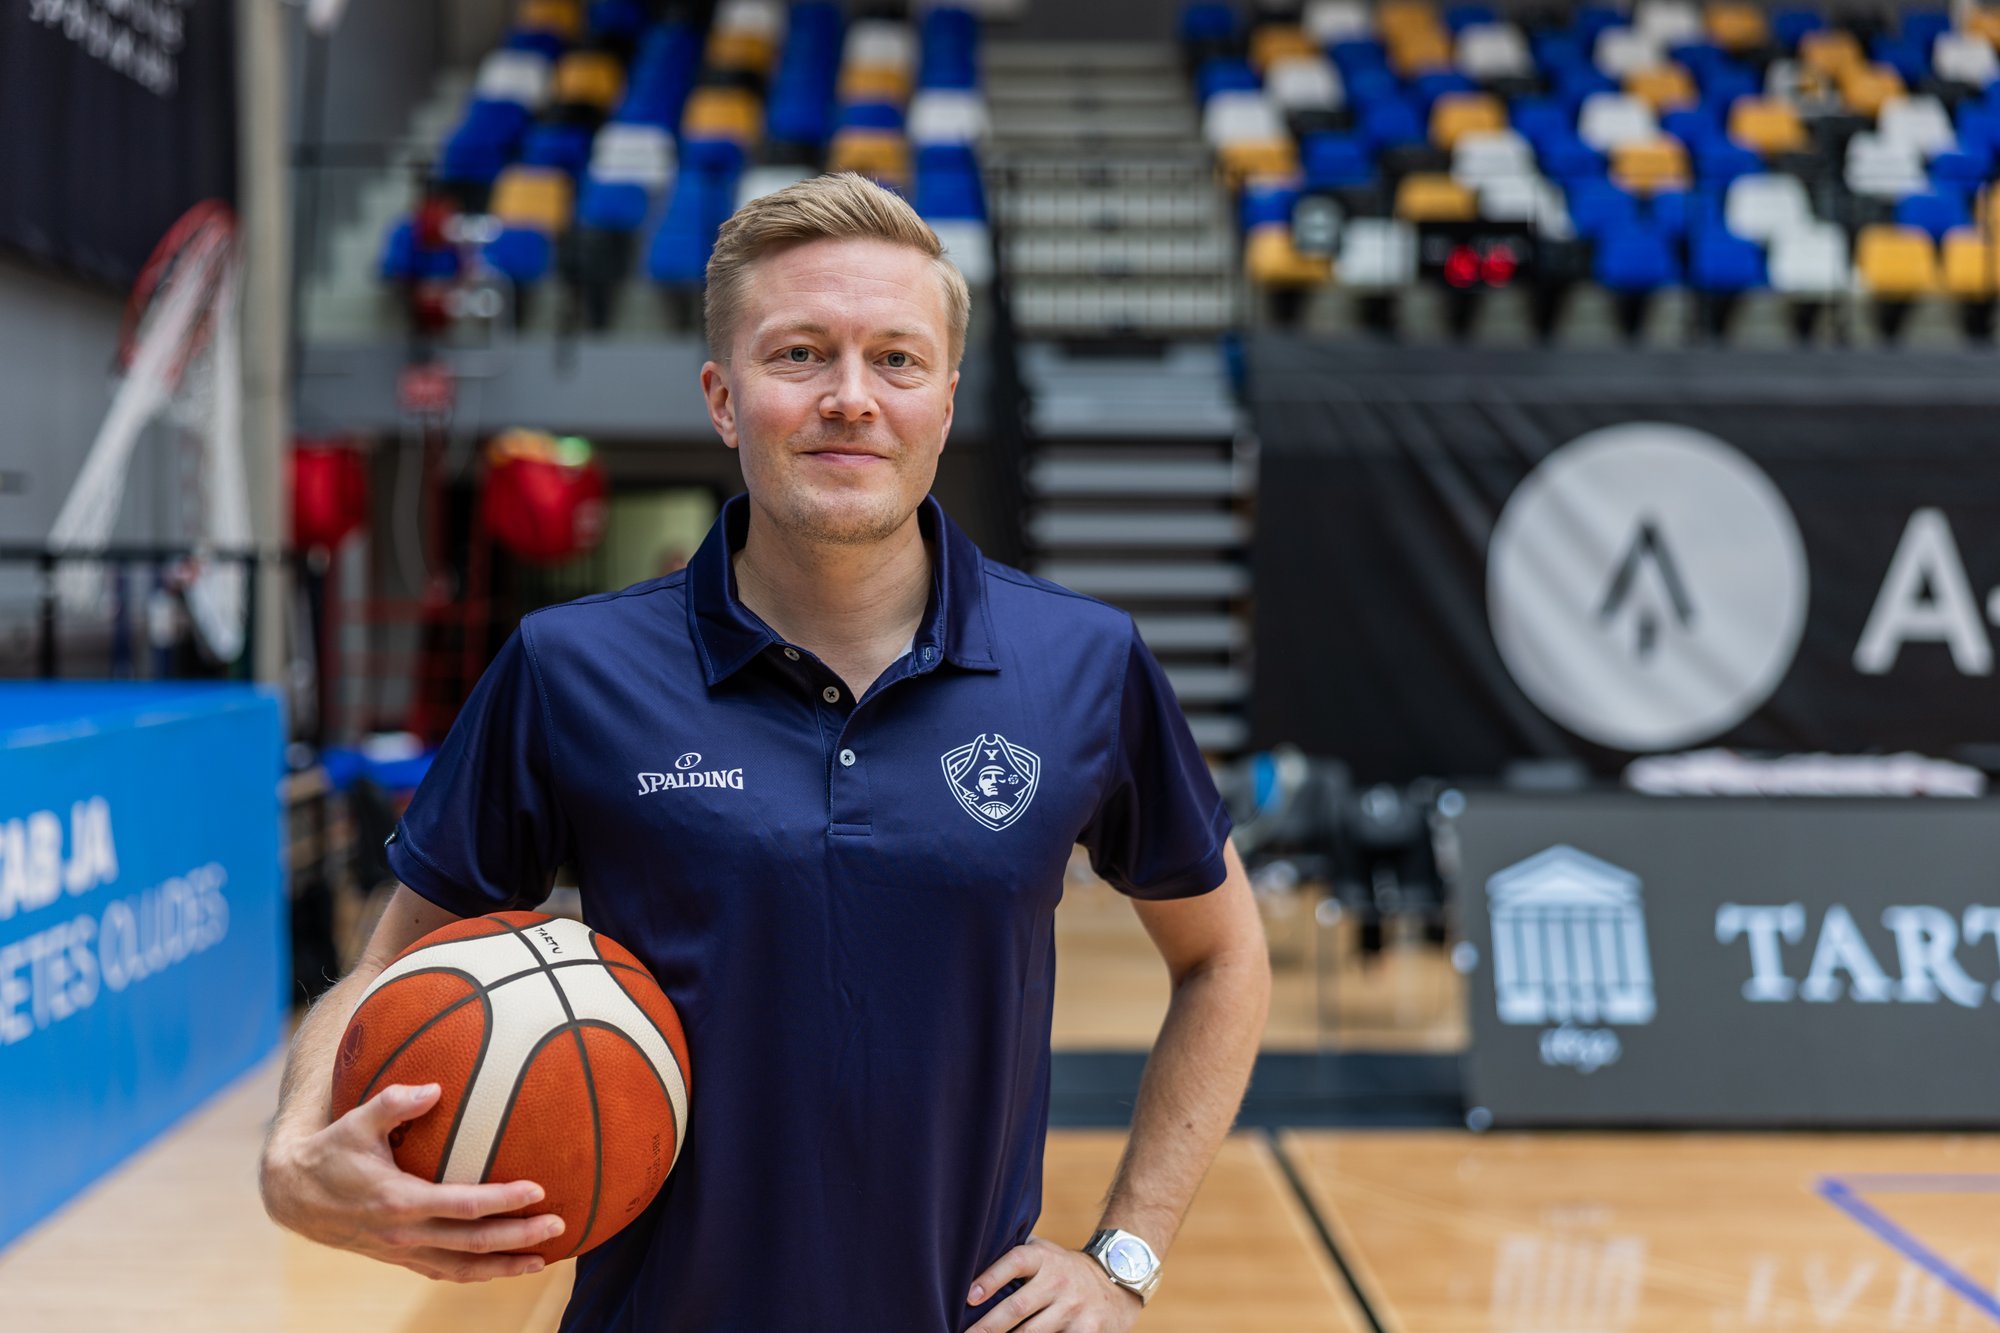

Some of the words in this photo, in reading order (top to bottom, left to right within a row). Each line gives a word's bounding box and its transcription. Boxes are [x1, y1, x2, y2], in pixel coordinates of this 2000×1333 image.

[1852, 506, 2000, 677] A
[637, 768, 744, 796] SPALDING
[0, 808, 64, 921] AB
[0, 914, 99, 1046] ETES
[534, 927, 564, 954] TARTU
